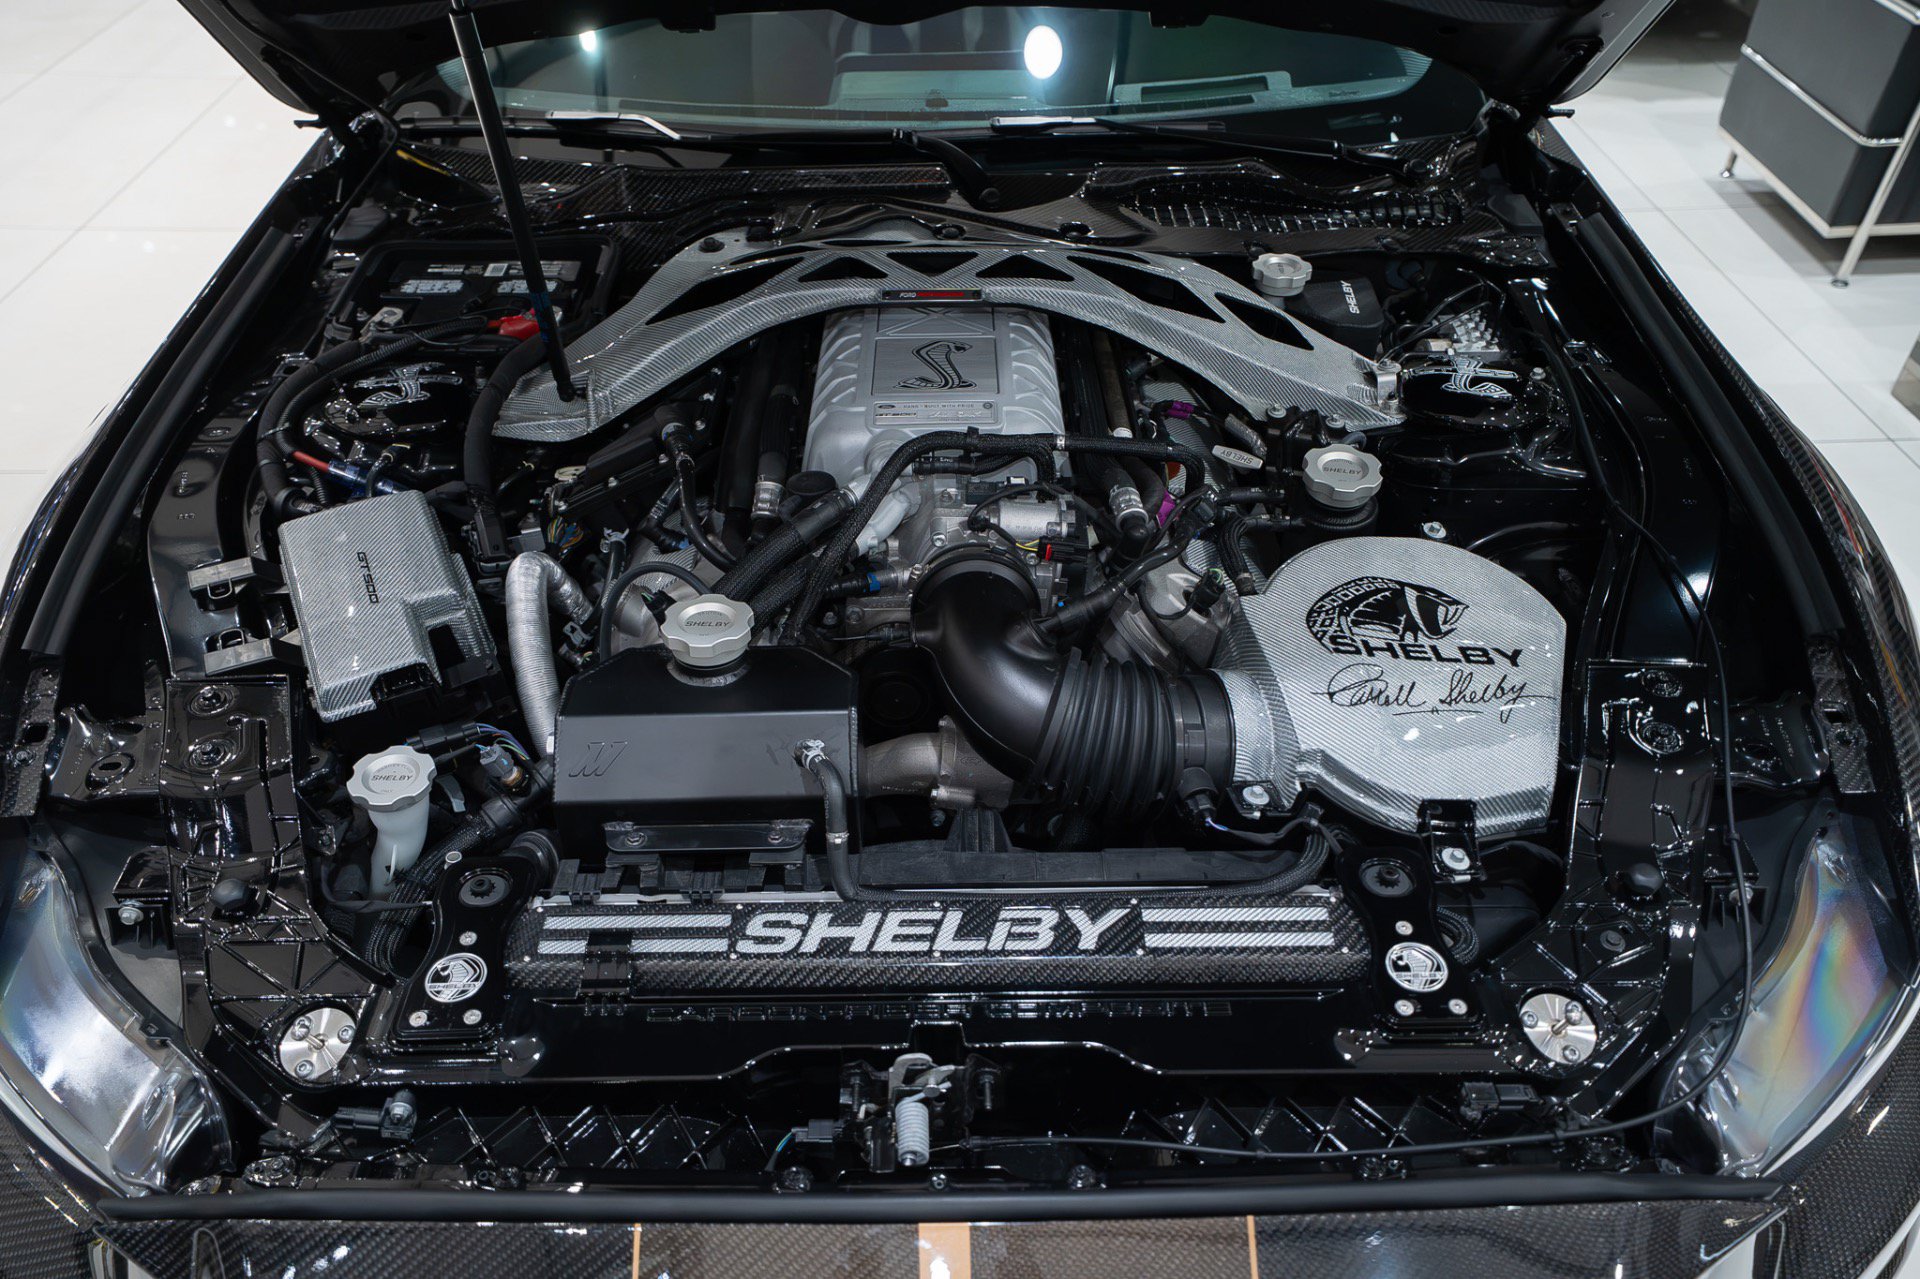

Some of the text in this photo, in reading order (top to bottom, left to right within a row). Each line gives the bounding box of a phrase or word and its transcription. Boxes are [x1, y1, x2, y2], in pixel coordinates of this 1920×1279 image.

[1340, 280, 1360, 314] SHELBY
[1220, 449, 1254, 466] SHELBY
[1322, 466, 1362, 475] SHELBY
[357, 551, 379, 604] GT500
[1329, 634, 1524, 668] SHELBY
[371, 774, 414, 782] SHELBY
[735, 905, 1132, 954] SHELBY
